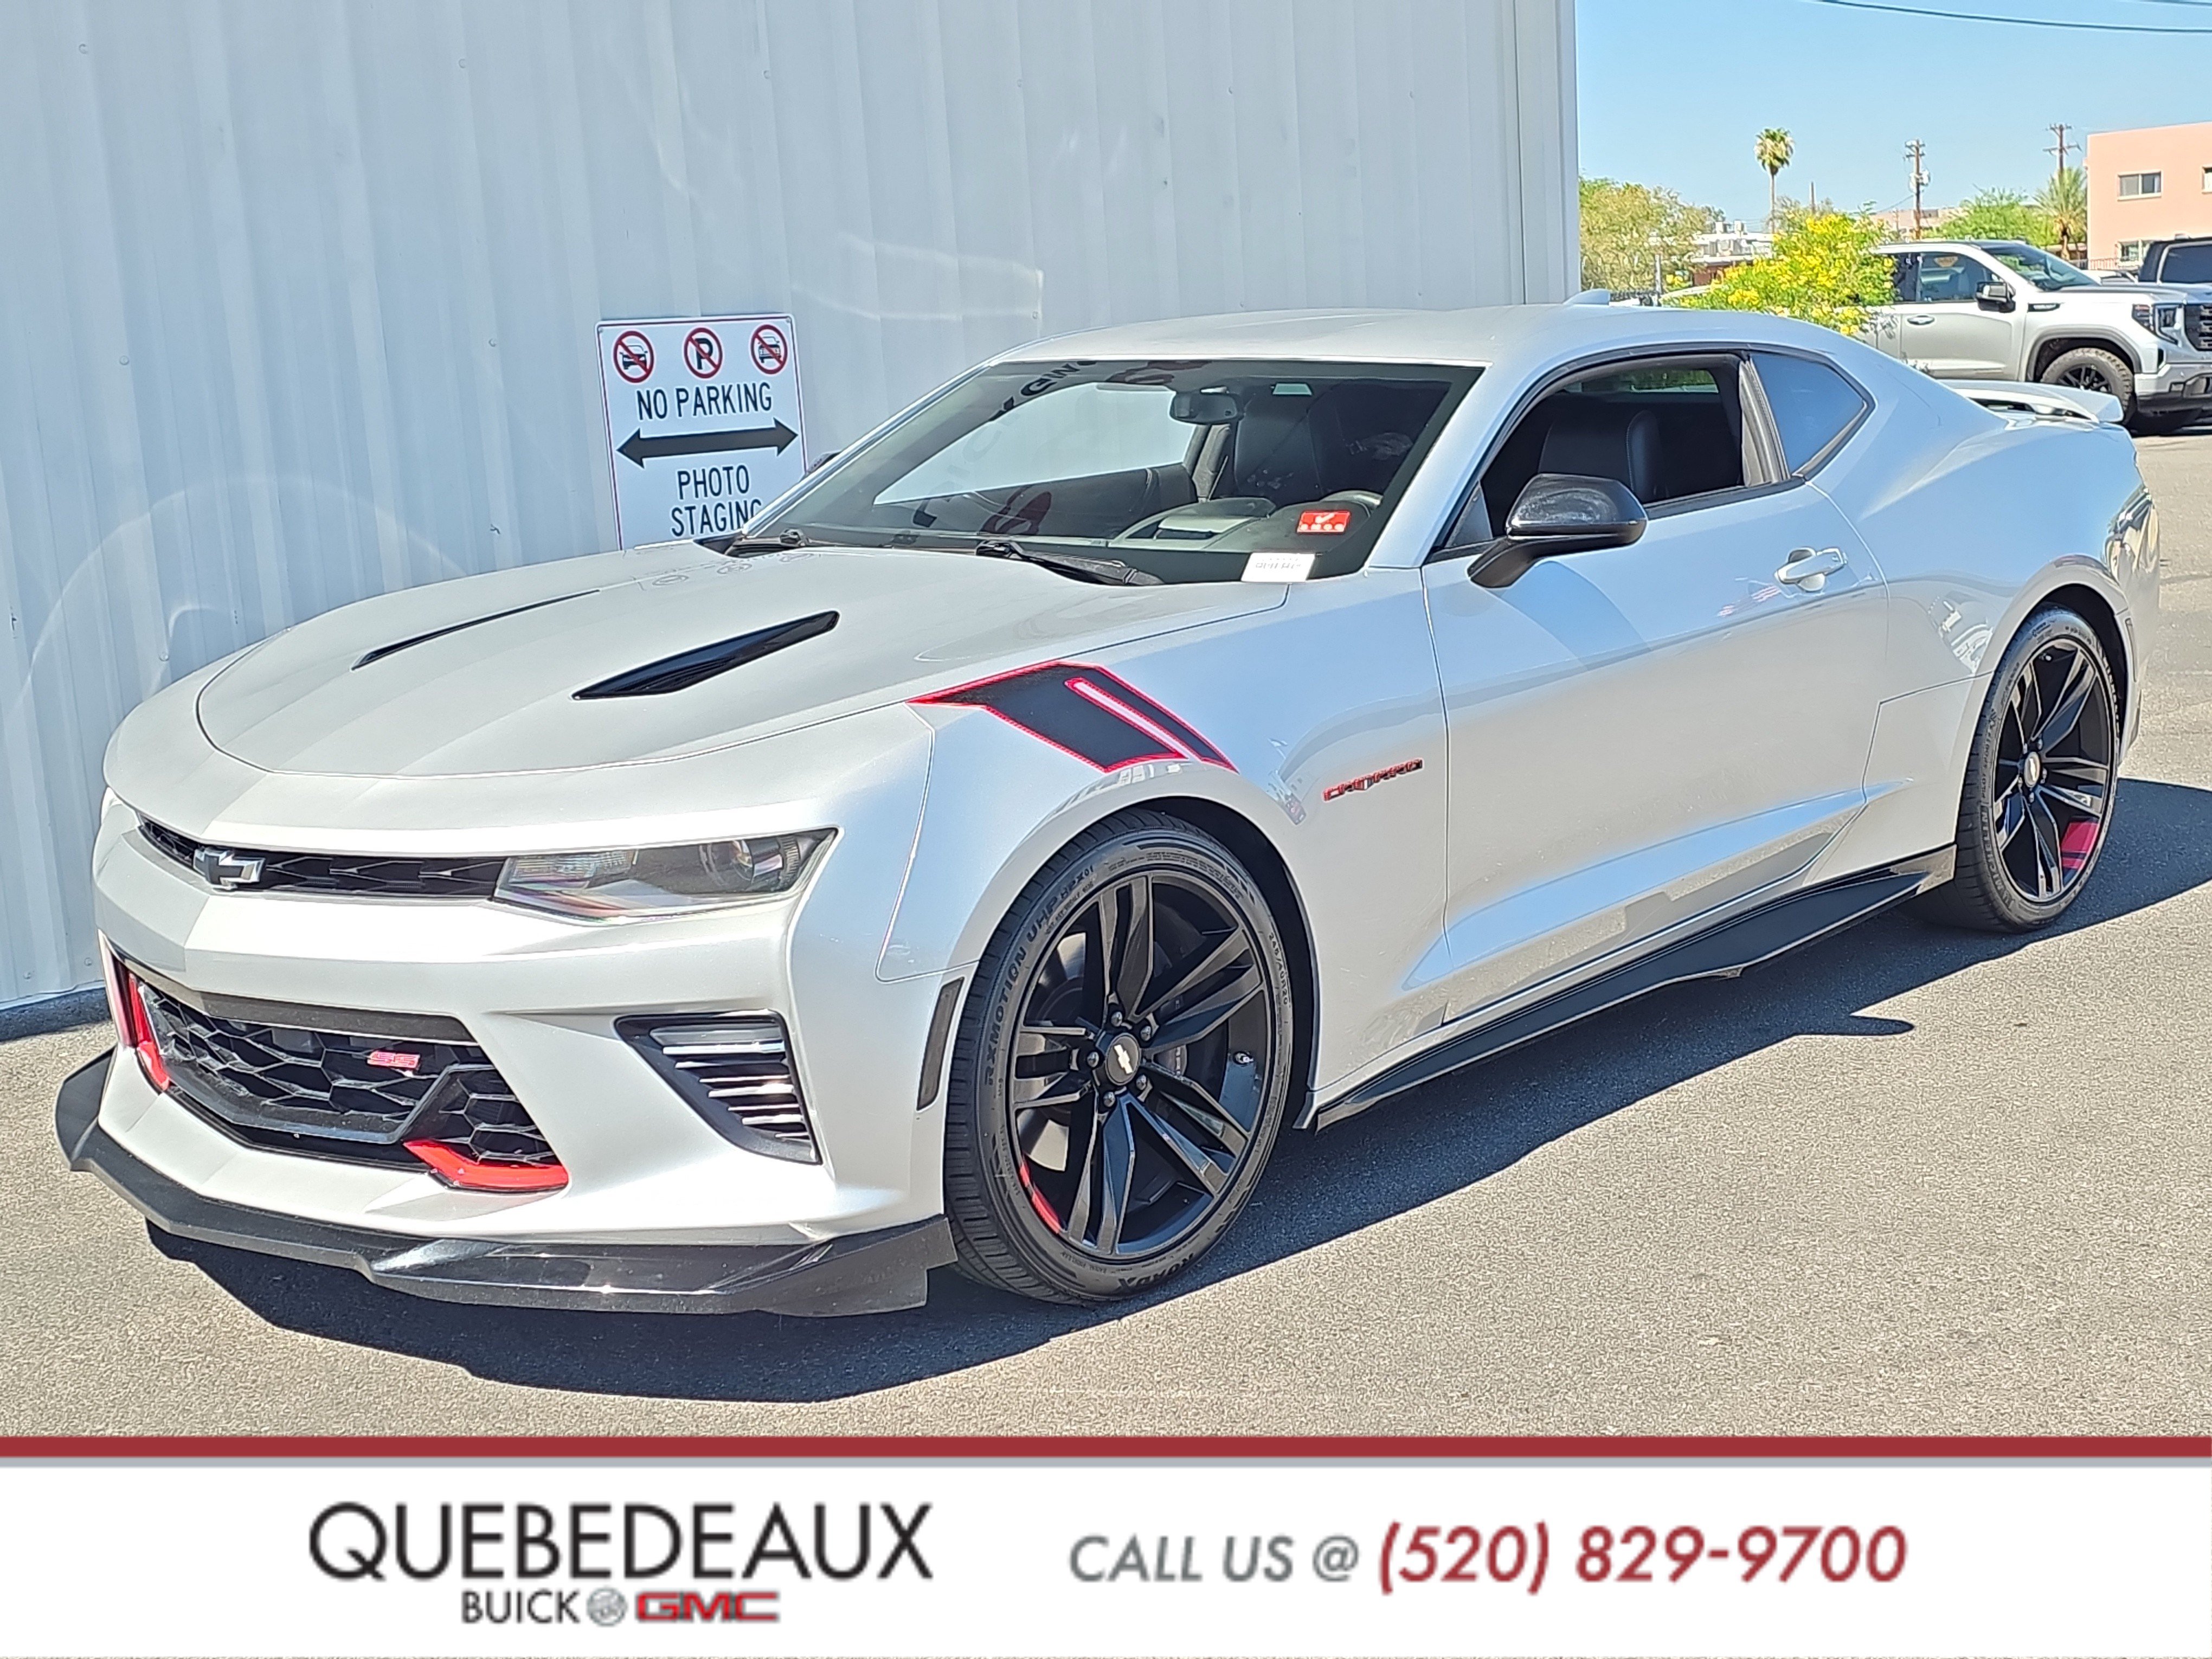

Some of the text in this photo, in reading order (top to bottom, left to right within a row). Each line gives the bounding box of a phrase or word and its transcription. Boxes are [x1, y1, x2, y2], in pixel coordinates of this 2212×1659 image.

[636, 382, 772, 420] NO PARKING
[677, 465, 749, 500] PHOTO
